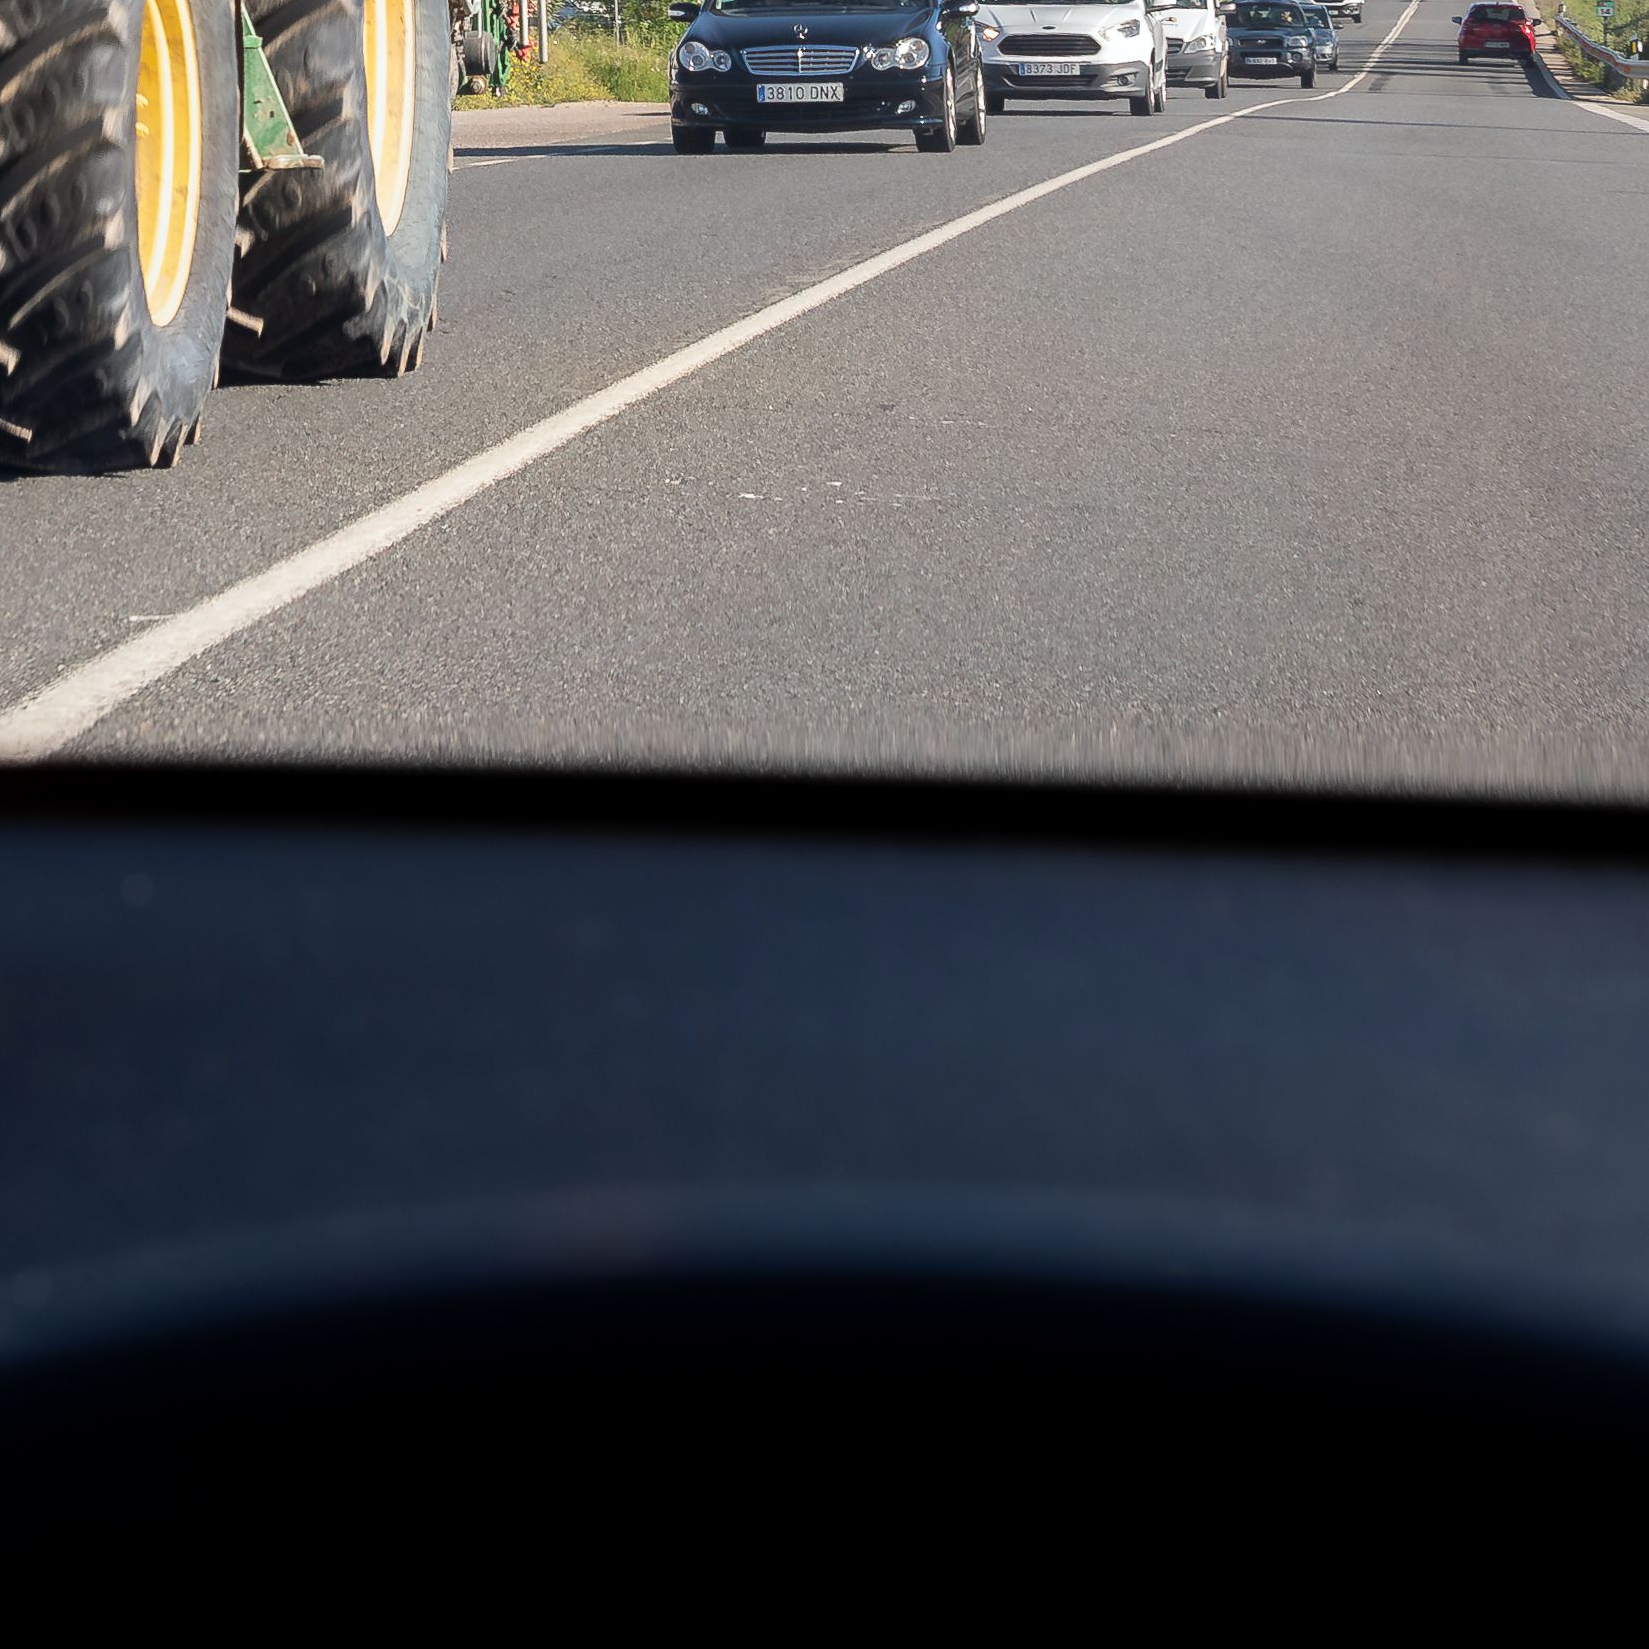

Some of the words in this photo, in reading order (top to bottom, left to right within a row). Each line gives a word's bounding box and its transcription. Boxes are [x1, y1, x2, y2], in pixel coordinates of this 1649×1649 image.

[1026, 64, 1053, 74] 8373
[767, 86, 805, 100] 3810
[810, 85, 841, 100] DNX
